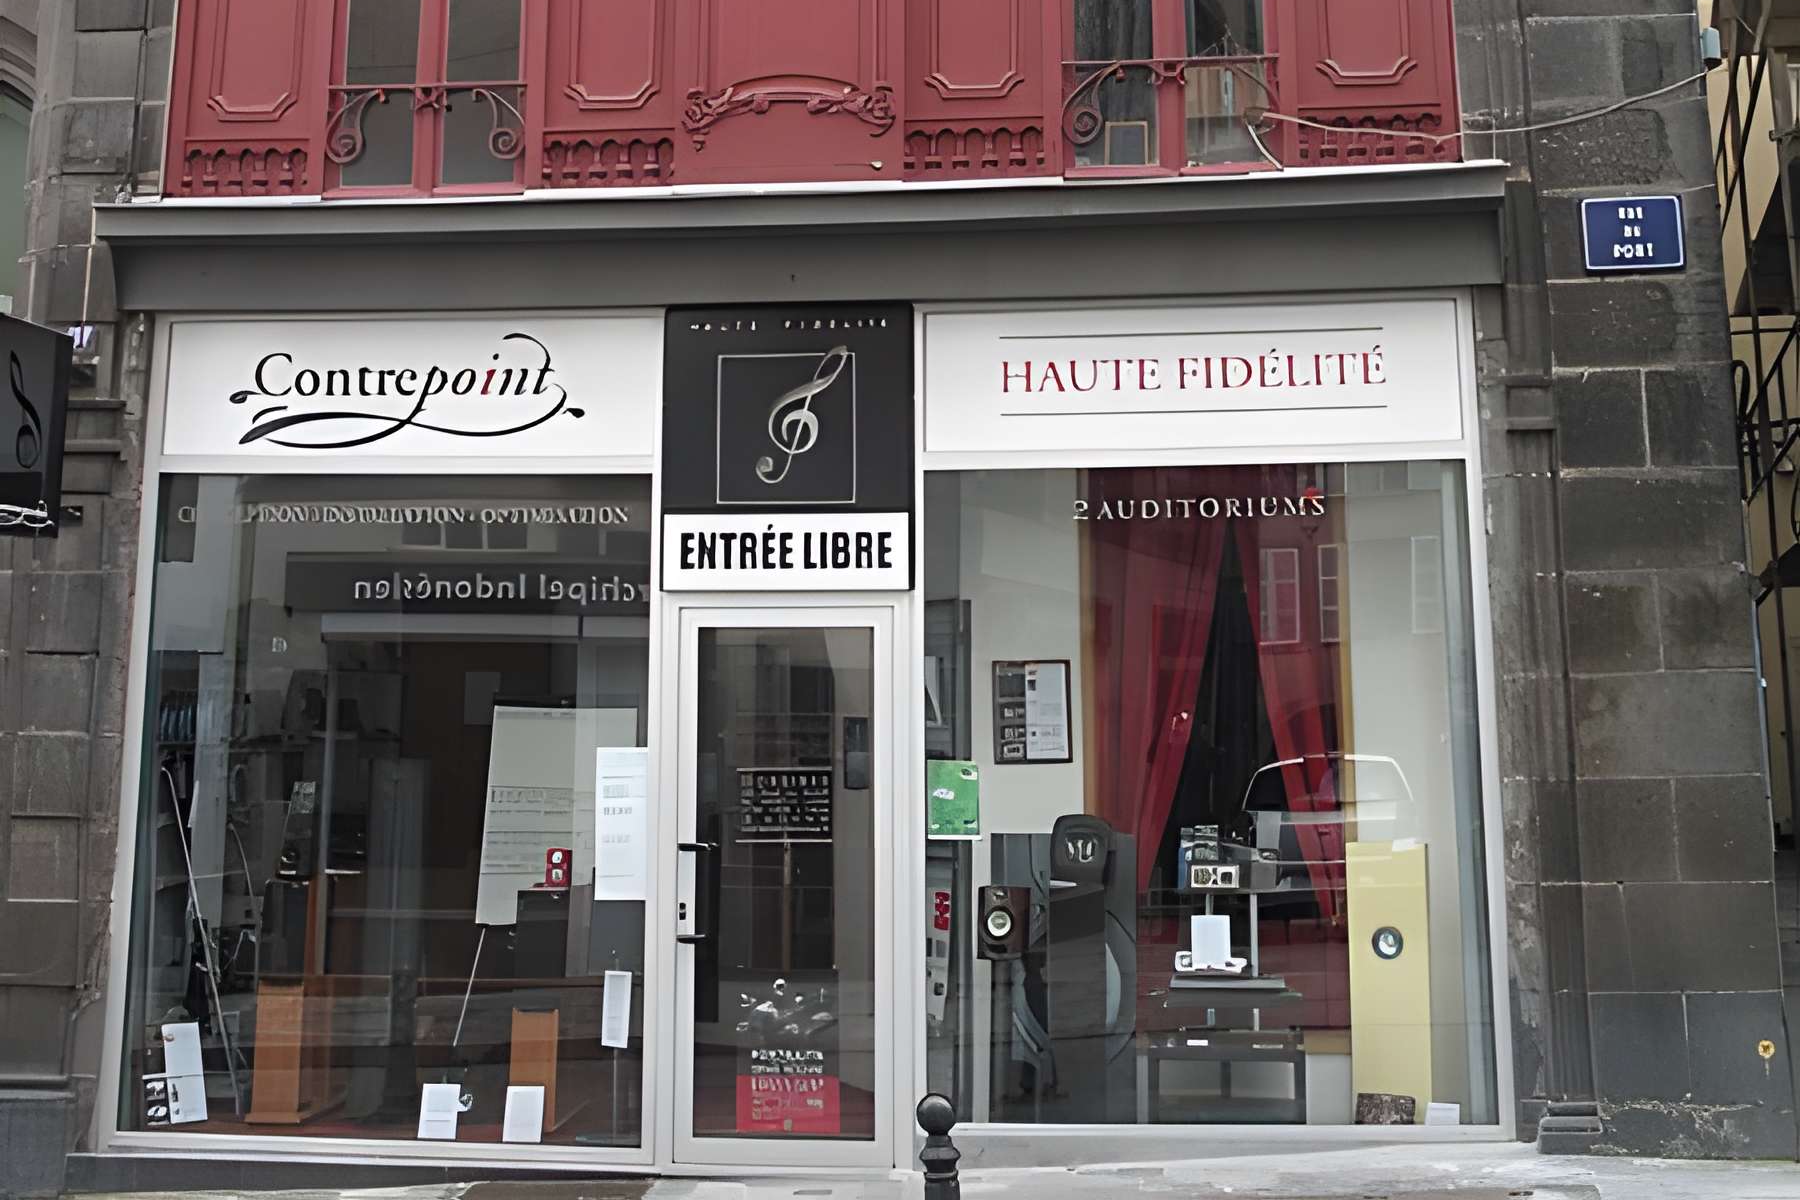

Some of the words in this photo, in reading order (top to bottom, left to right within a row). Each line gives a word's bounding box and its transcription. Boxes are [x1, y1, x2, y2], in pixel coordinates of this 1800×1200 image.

[254, 333, 556, 422] Contrepoint
[1002, 359, 1162, 393] HAUTE
[1178, 345, 1387, 390] FIDÉLITÉ
[1096, 496, 1325, 520] AUDITORIUMS
[680, 523, 794, 570] ENTRÉE
[803, 531, 892, 569] LIBRE
